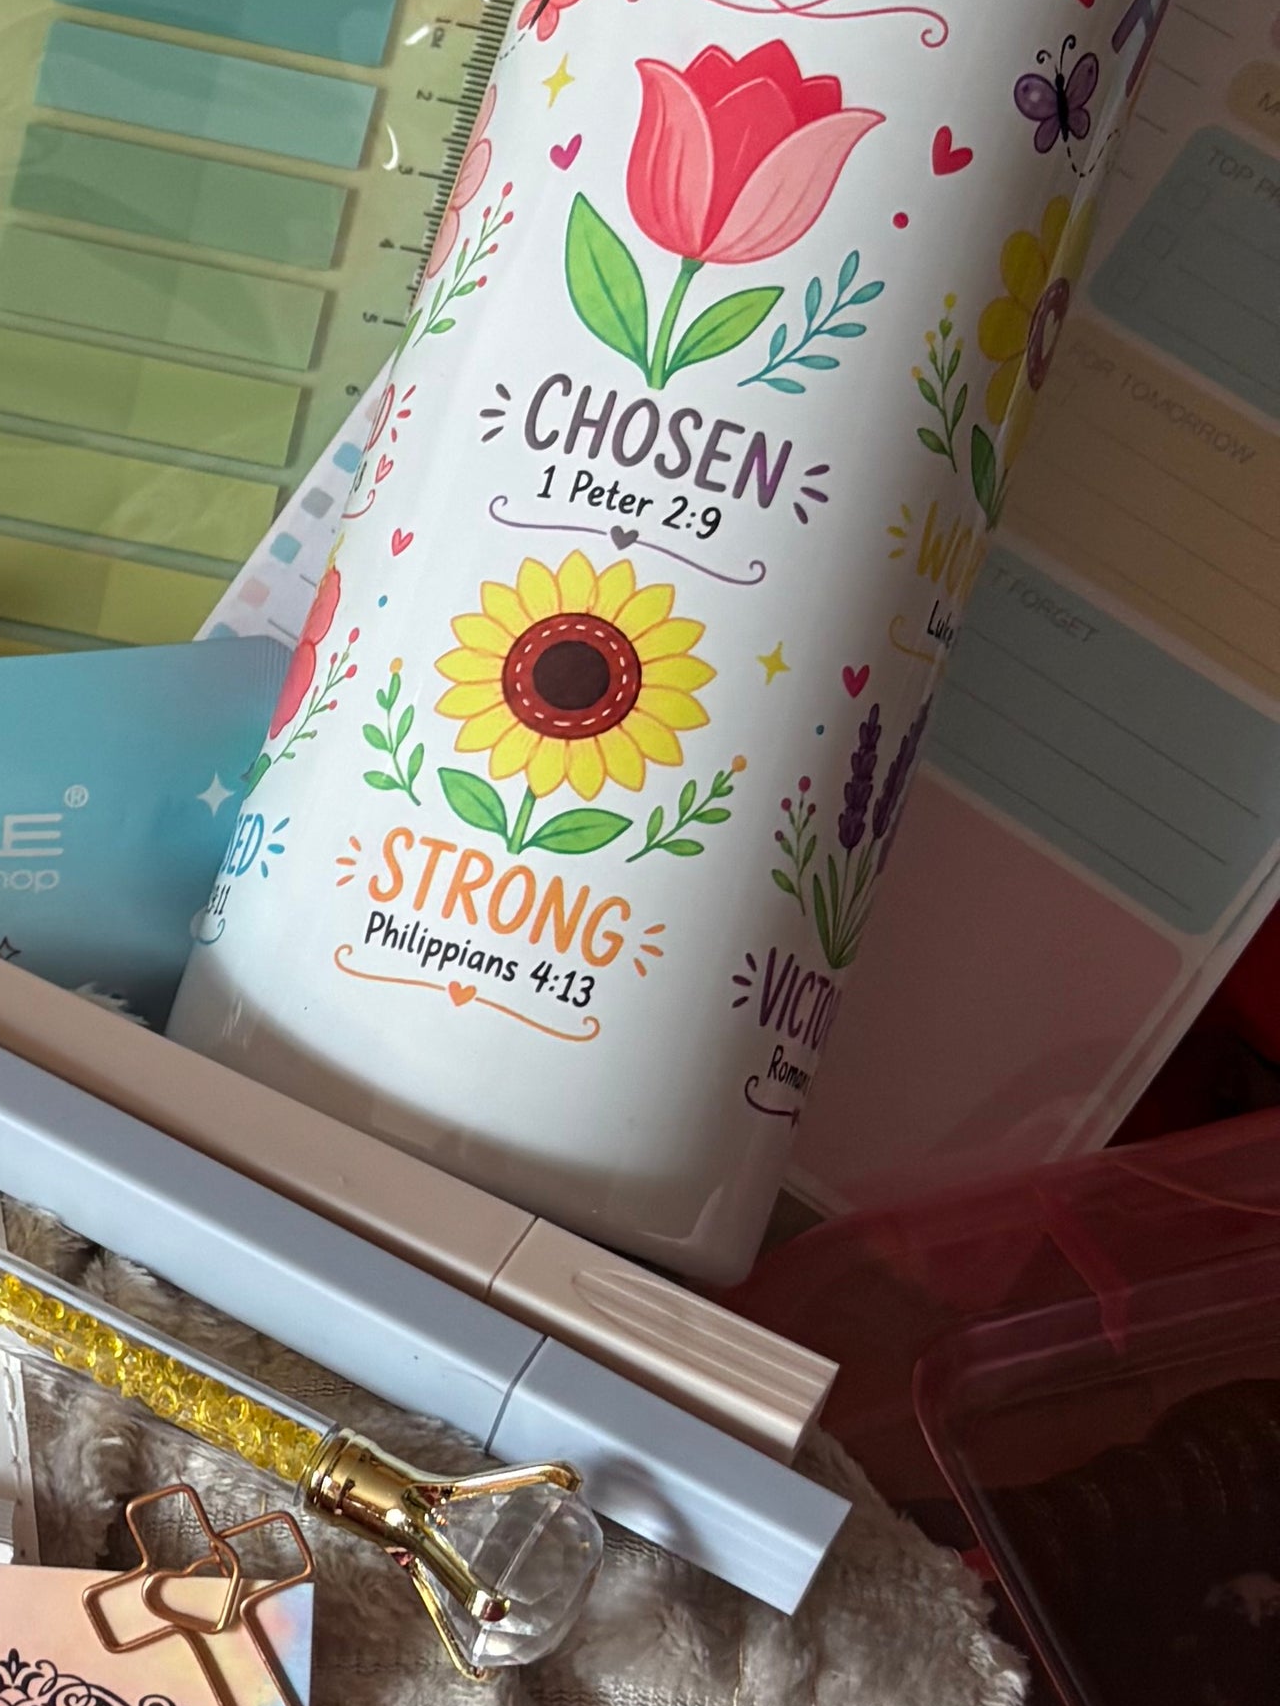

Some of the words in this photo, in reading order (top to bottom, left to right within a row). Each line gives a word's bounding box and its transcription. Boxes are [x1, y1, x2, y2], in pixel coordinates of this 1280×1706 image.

[524, 373, 794, 509] CHOSEN
[536, 465, 555, 500] 1
[568, 470, 653, 519] Peter
[662, 496, 723, 540] 2:9
[368, 827, 632, 967] STRONG
[365, 911, 519, 984] Philippians
[530, 961, 597, 1009] 4:13
